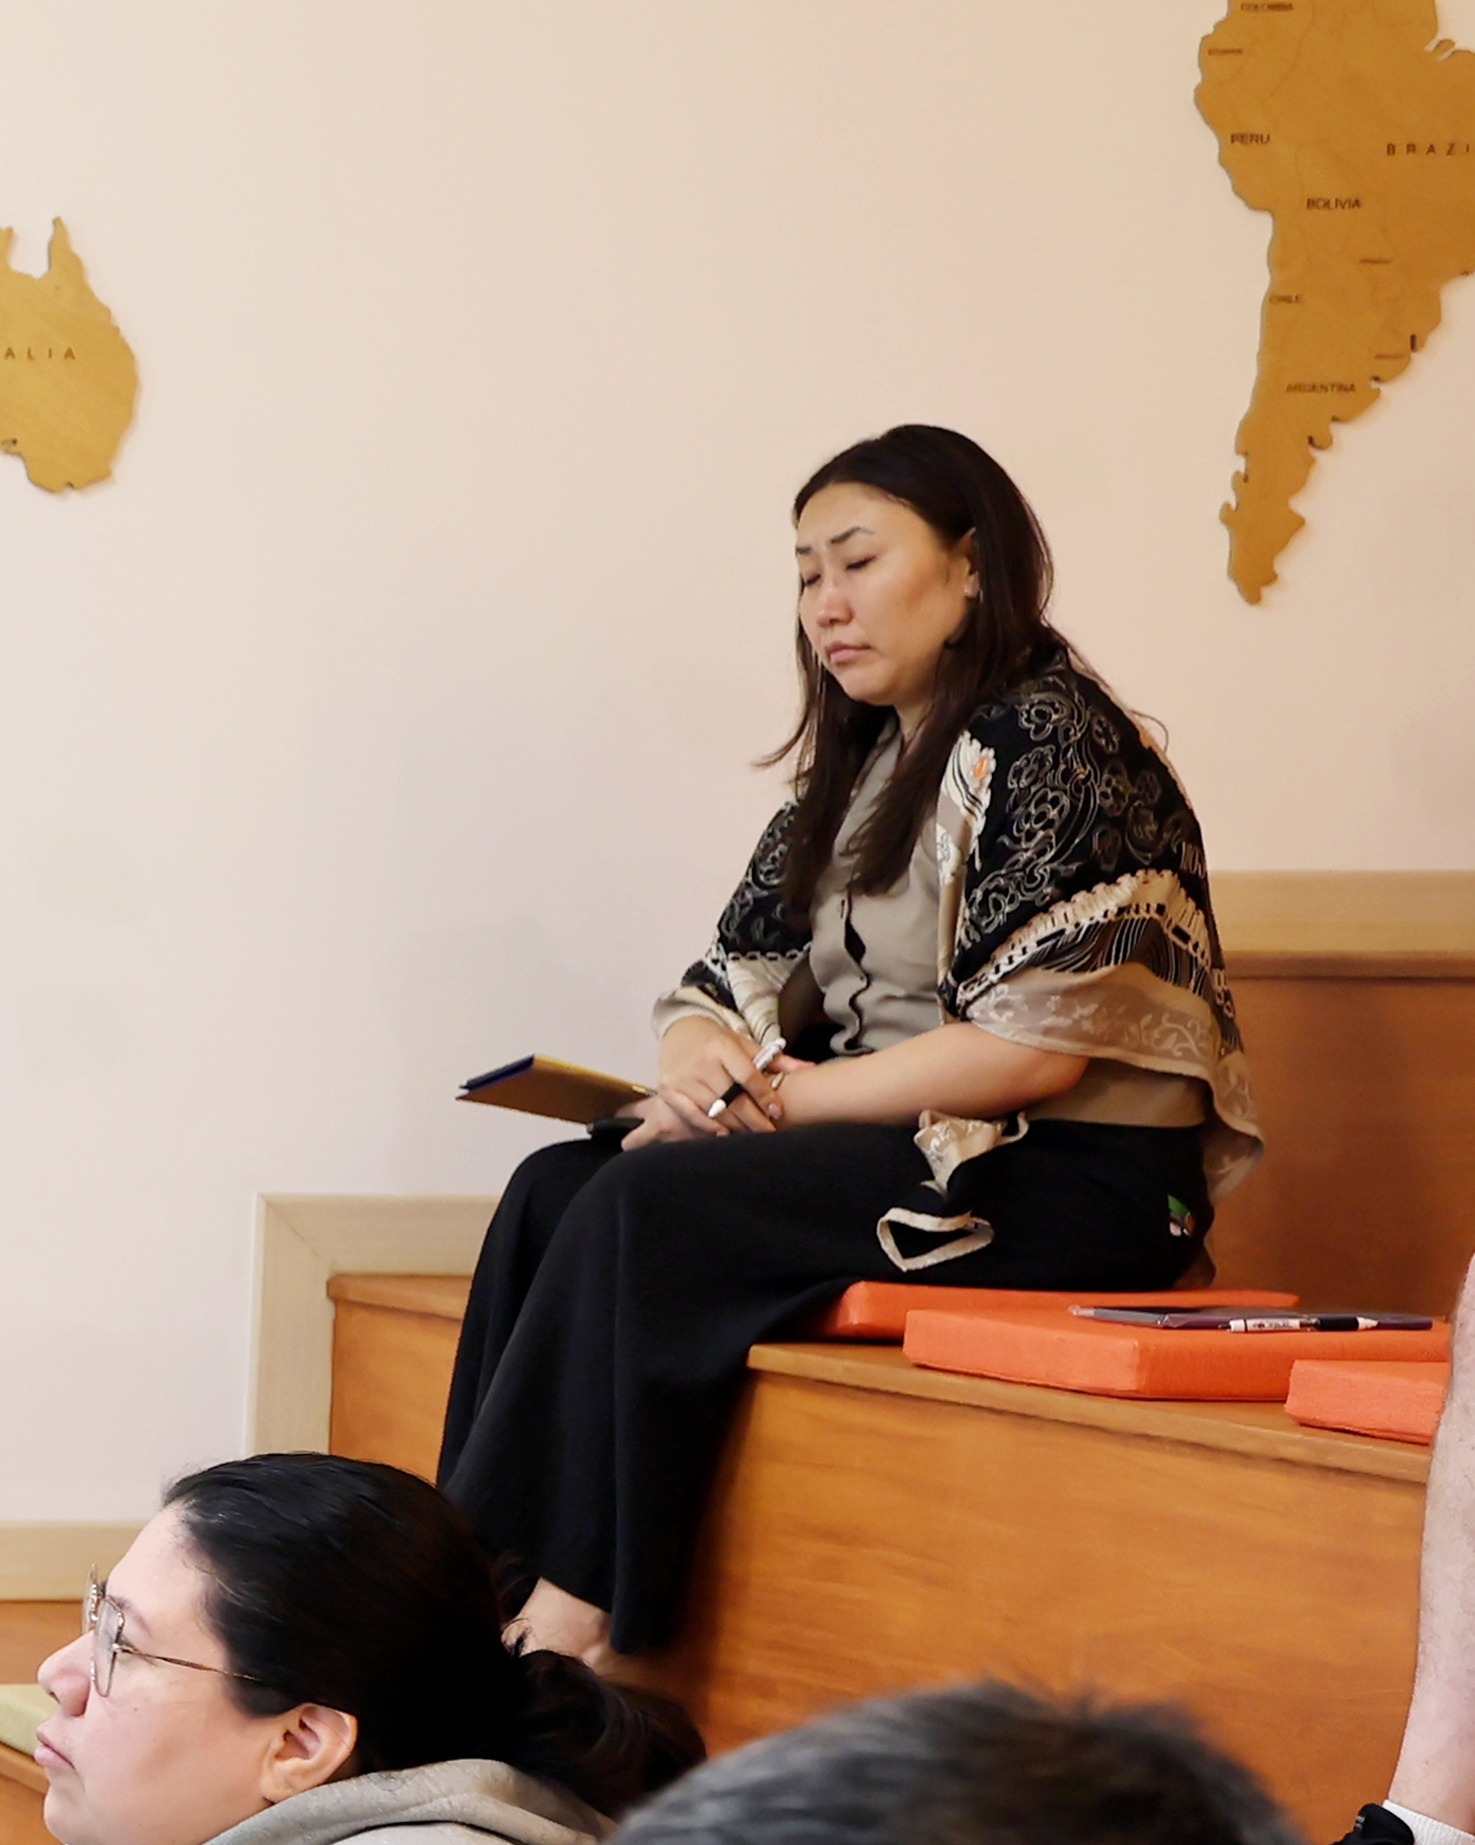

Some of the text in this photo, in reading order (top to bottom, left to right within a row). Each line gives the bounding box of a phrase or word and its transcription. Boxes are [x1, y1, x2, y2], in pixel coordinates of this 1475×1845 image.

[1230, 133, 1271, 145] PERU
[1386, 142, 1471, 156] BRAZI
[1306, 197, 1362, 210] BOLIVIA
